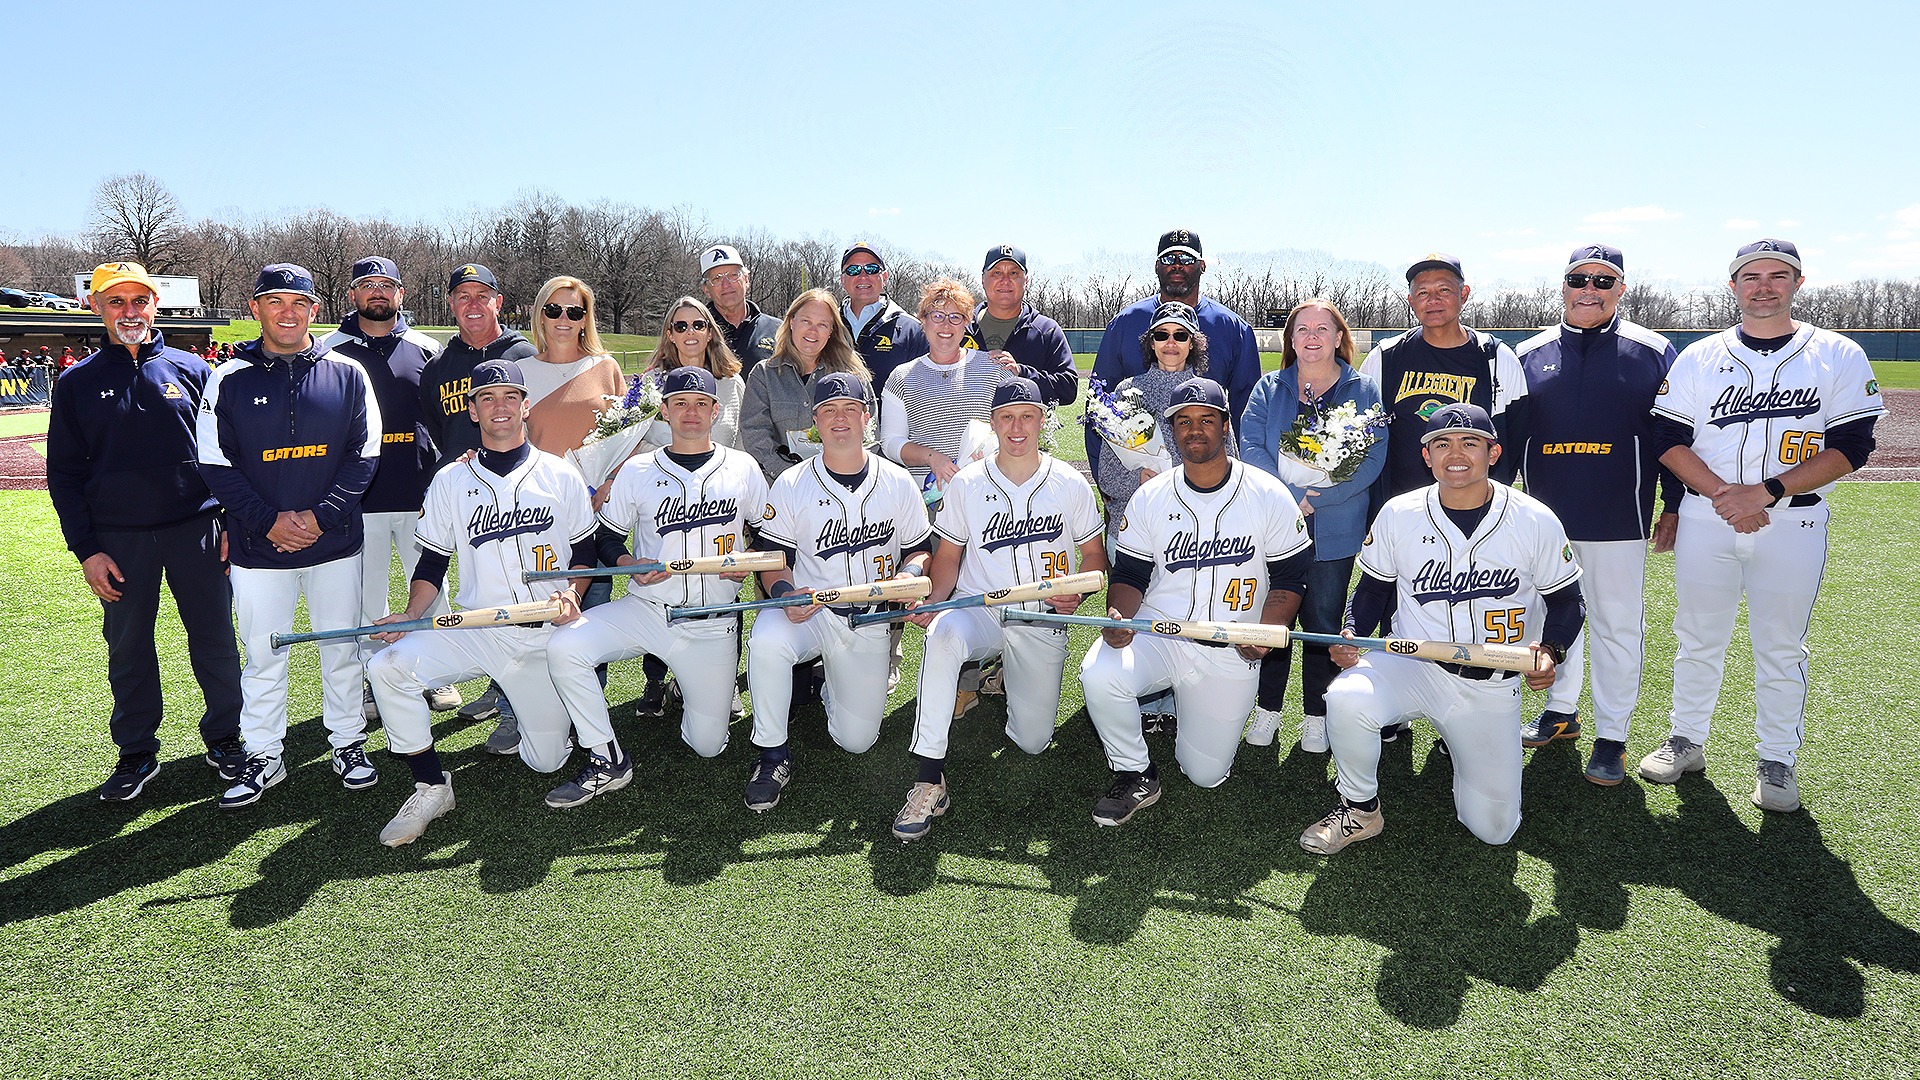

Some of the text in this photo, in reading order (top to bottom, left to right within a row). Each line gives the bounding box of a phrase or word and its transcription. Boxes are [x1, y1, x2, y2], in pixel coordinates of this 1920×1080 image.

[1169, 229, 1190, 243] 43
[0, 378, 31, 397] NY
[1394, 371, 1477, 404] ALLEGHENY
[1709, 383, 1821, 421] Allegheny
[262, 444, 328, 462] GATORS
[1542, 442, 1613, 455] GATORS
[1779, 429, 1825, 464] 66
[466, 504, 555, 541] Allegheny
[654, 496, 738, 531] Allegheny
[981, 510, 1064, 548] Allegheny
[814, 517, 896, 554] Allegheny
[1163, 531, 1256, 570] Allegheny
[531, 544, 561, 572] 12
[669, 560, 695, 571] SHB
[873, 554, 895, 583] 33
[1041, 550, 1069, 581] 39
[1222, 578, 1258, 612] 43
[1411, 559, 1521, 603] Allegheny
[437, 614, 464, 627] SHB
[1483, 608, 1526, 644] 55
[1389, 641, 1419, 654] SHB
